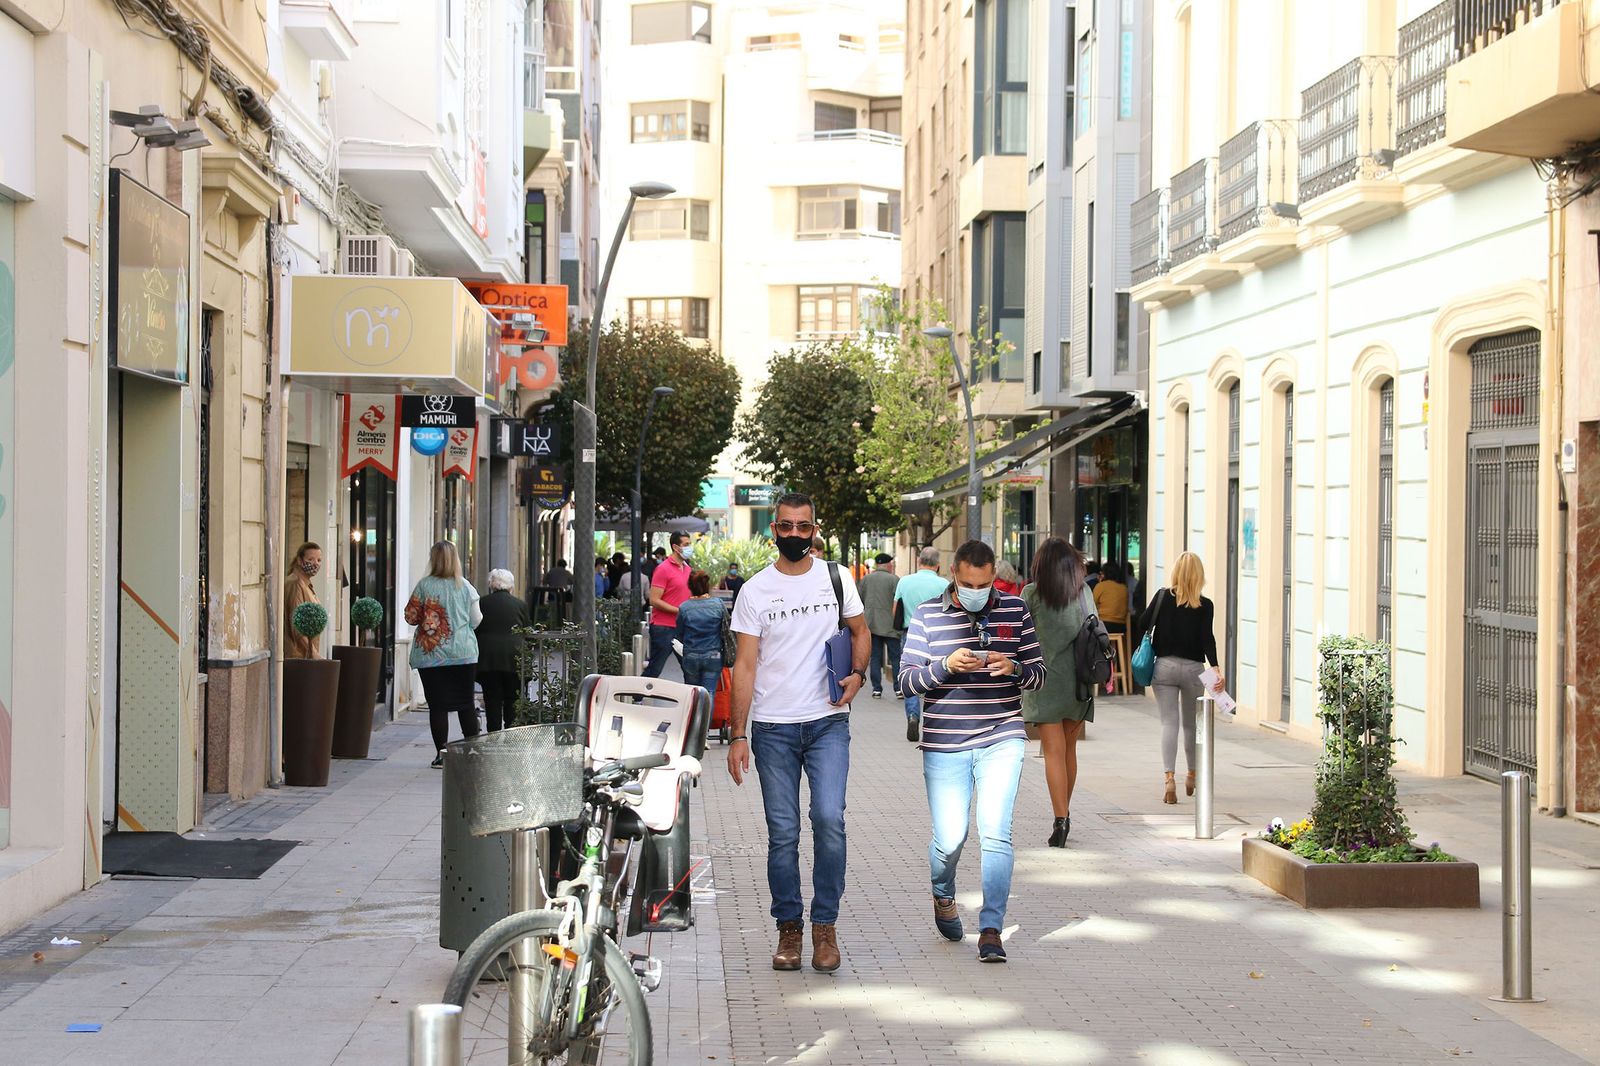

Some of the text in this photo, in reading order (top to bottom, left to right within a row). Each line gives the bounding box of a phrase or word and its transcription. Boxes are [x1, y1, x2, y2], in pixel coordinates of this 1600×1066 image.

[419, 414, 457, 425] MAMUHI
[357, 436, 386, 444] centro
[413, 432, 445, 441] DIGI
[358, 447, 384, 455] MERRY
[532, 483, 563, 491] TABACOS
